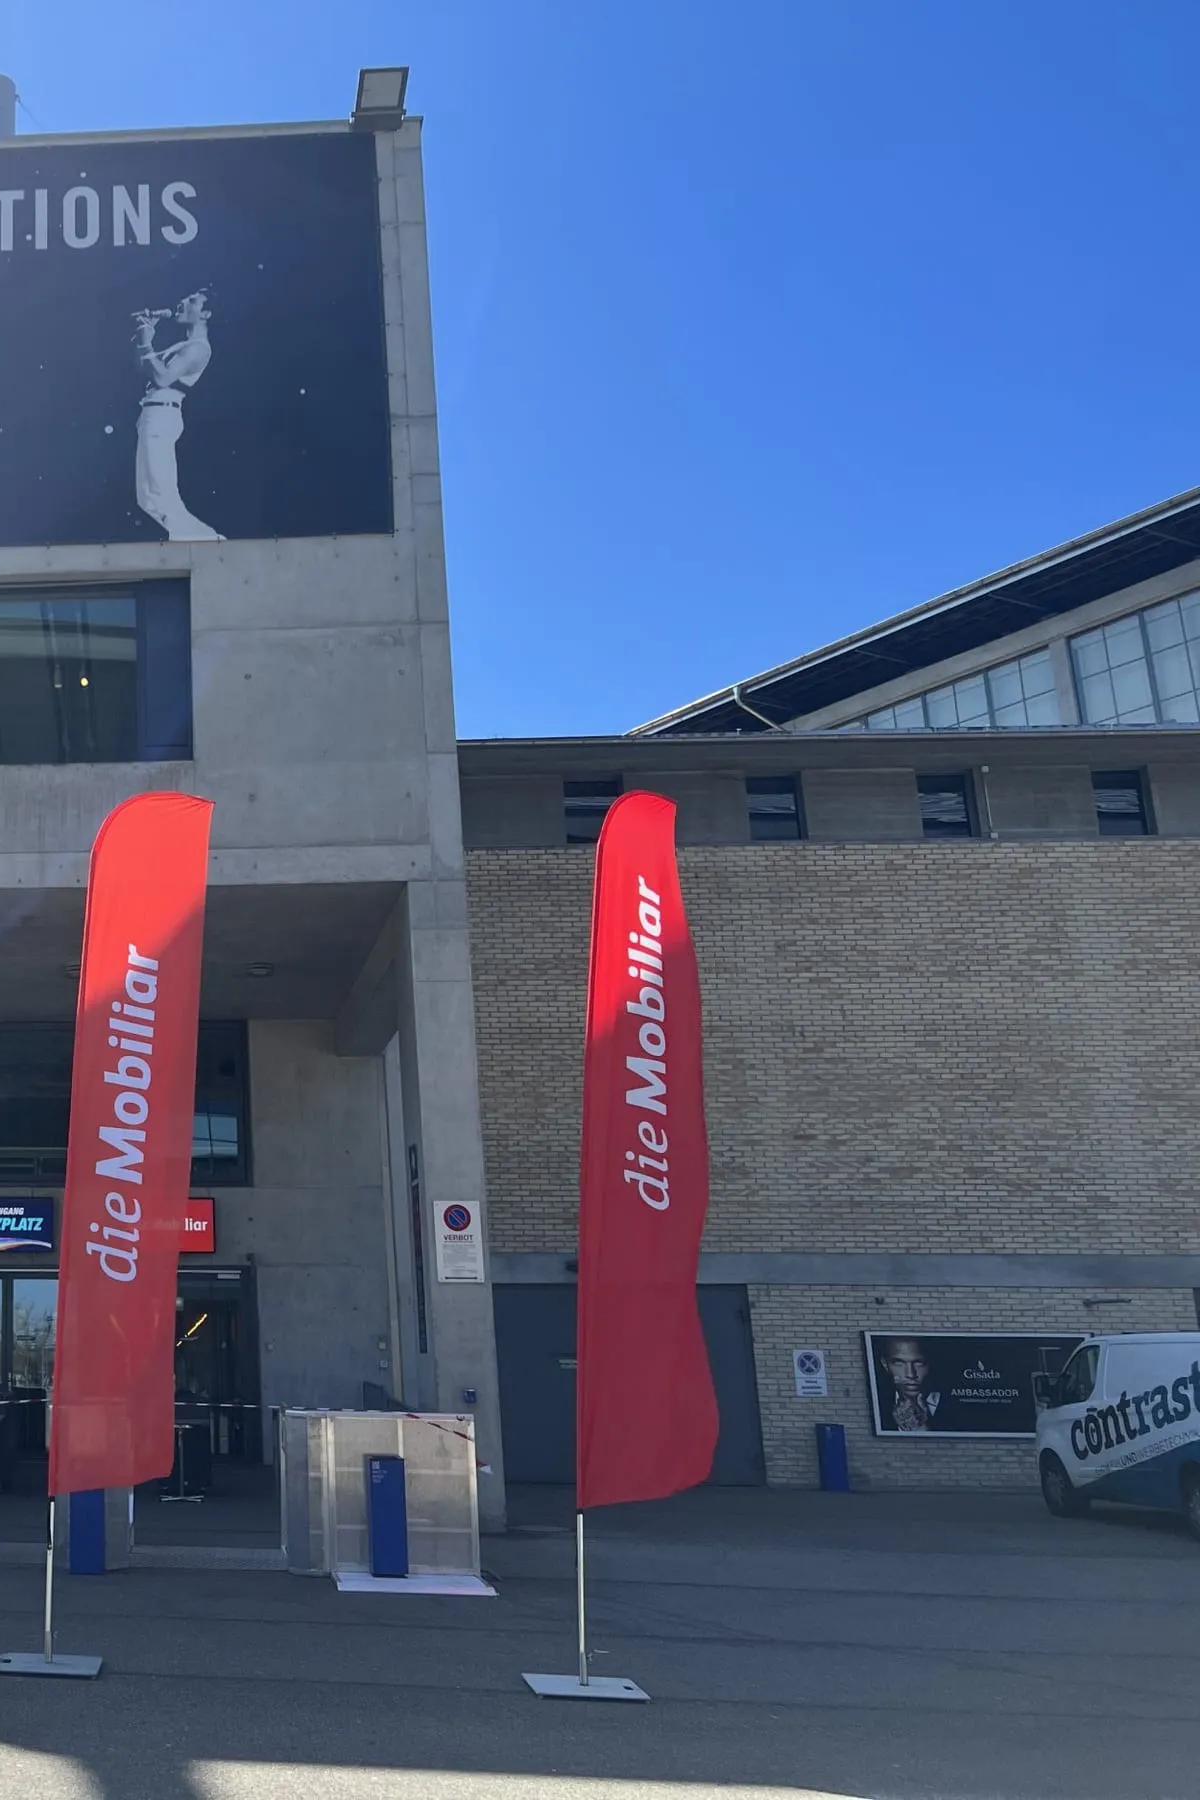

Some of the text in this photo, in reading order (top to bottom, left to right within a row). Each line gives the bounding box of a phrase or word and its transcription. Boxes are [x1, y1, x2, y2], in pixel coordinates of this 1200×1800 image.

[623, 874, 672, 1212] die Mobiliar
[86, 943, 160, 1283] die Mobiliar
[443, 1233, 474, 1242] VERBOT
[963, 1368, 1001, 1379] Gisada
[950, 1388, 1020, 1398] AMBASSADOR
